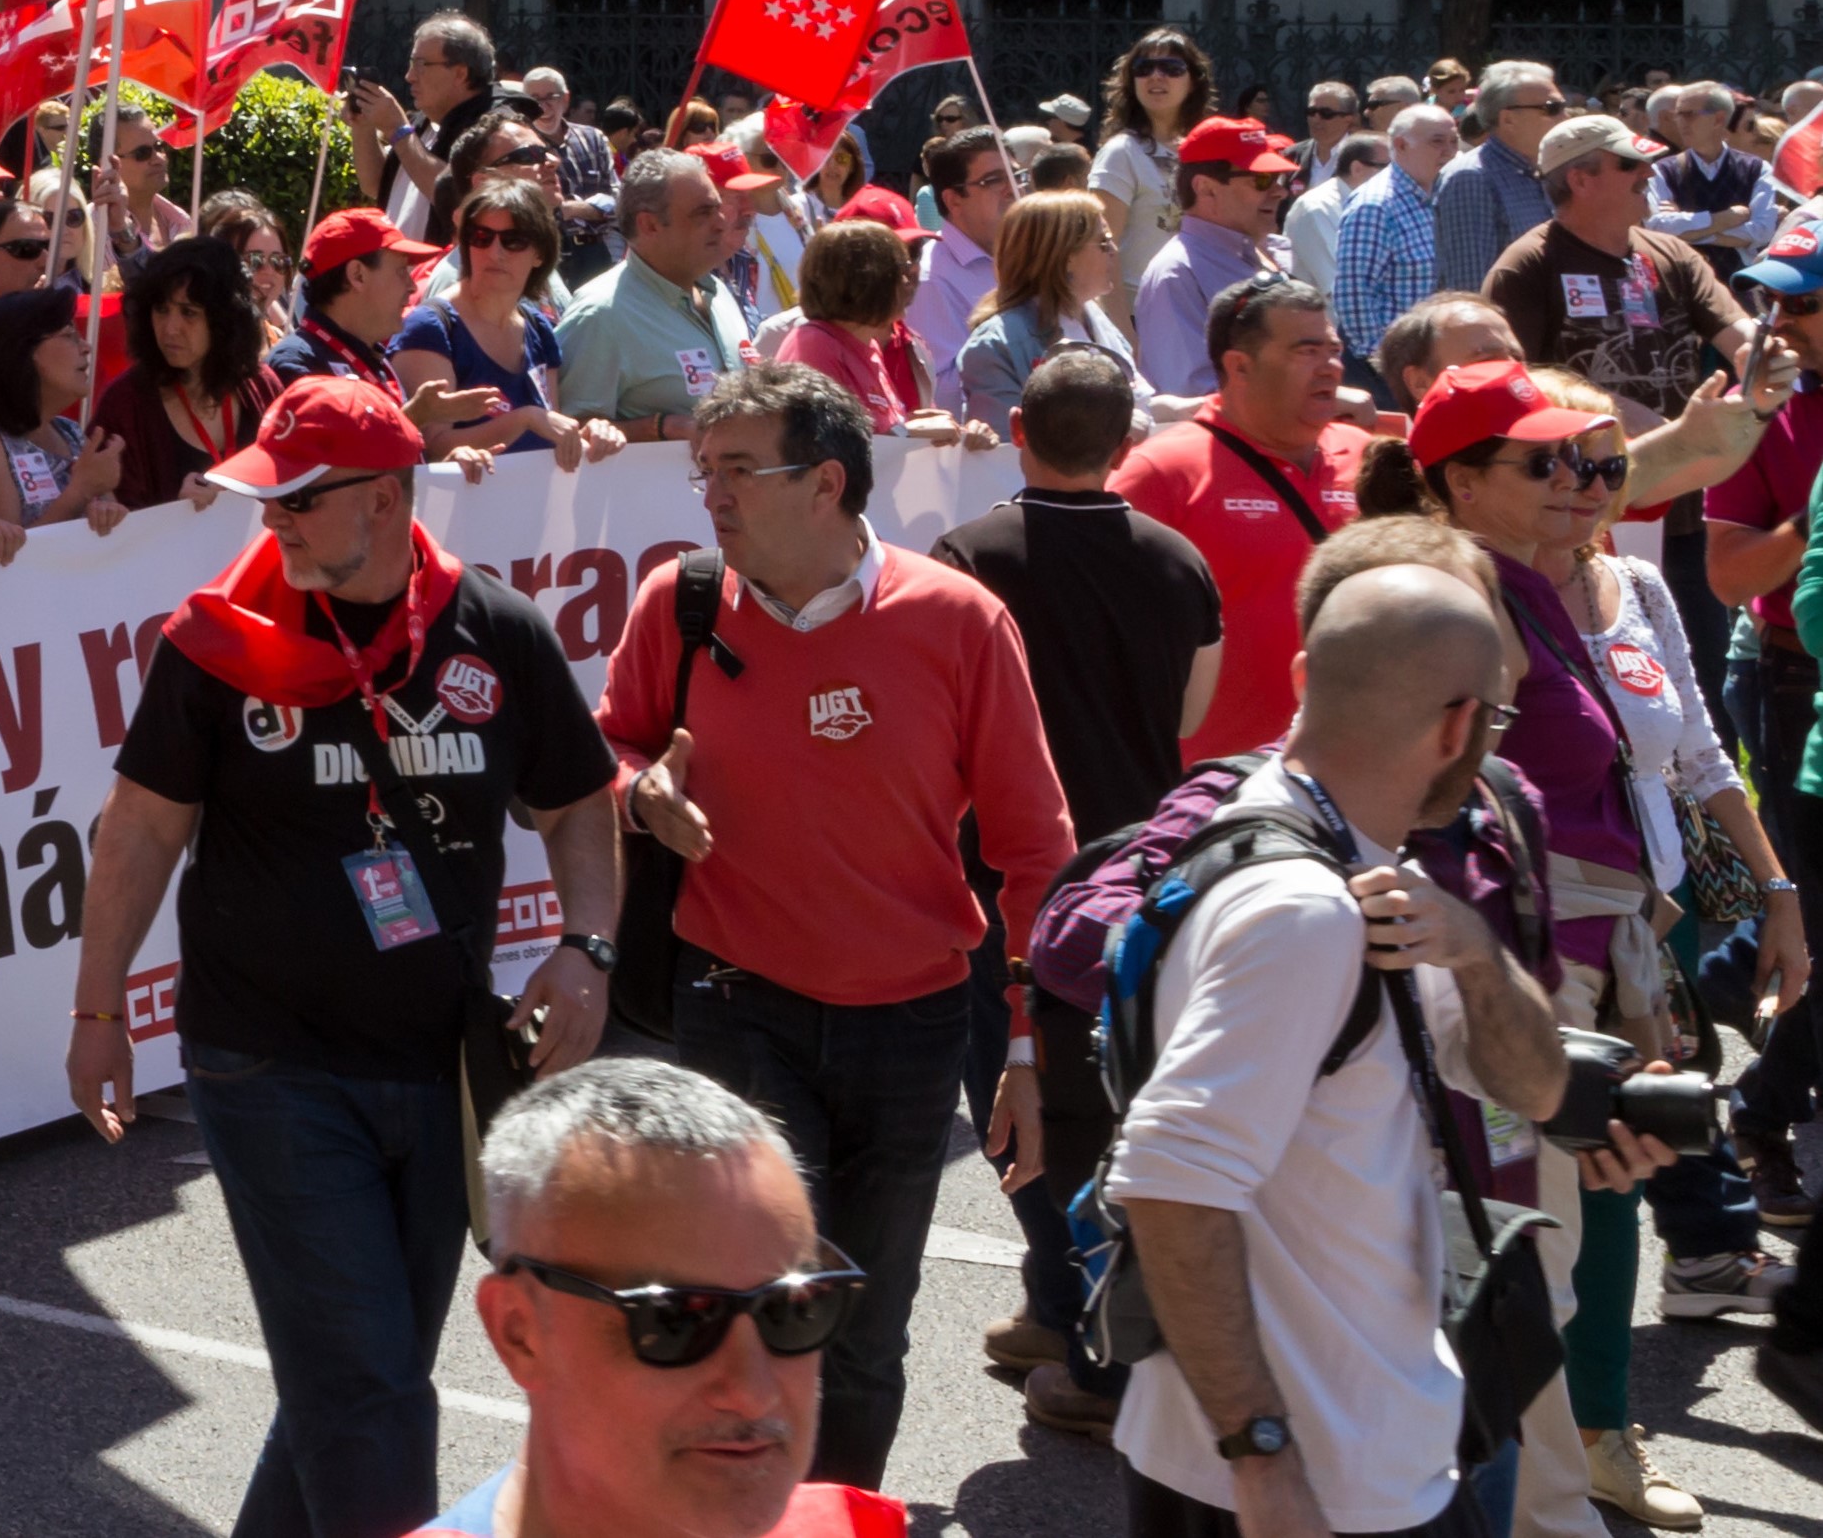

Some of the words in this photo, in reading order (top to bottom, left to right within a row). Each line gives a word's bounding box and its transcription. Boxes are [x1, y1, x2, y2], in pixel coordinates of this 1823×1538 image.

[1224, 498, 1280, 514] CCOO
[444, 659, 498, 699] UGT
[1610, 649, 1657, 678] UGT
[809, 686, 864, 724] UGT
[313, 731, 487, 786] DIIDAD
[128, 968, 176, 1029] CC
